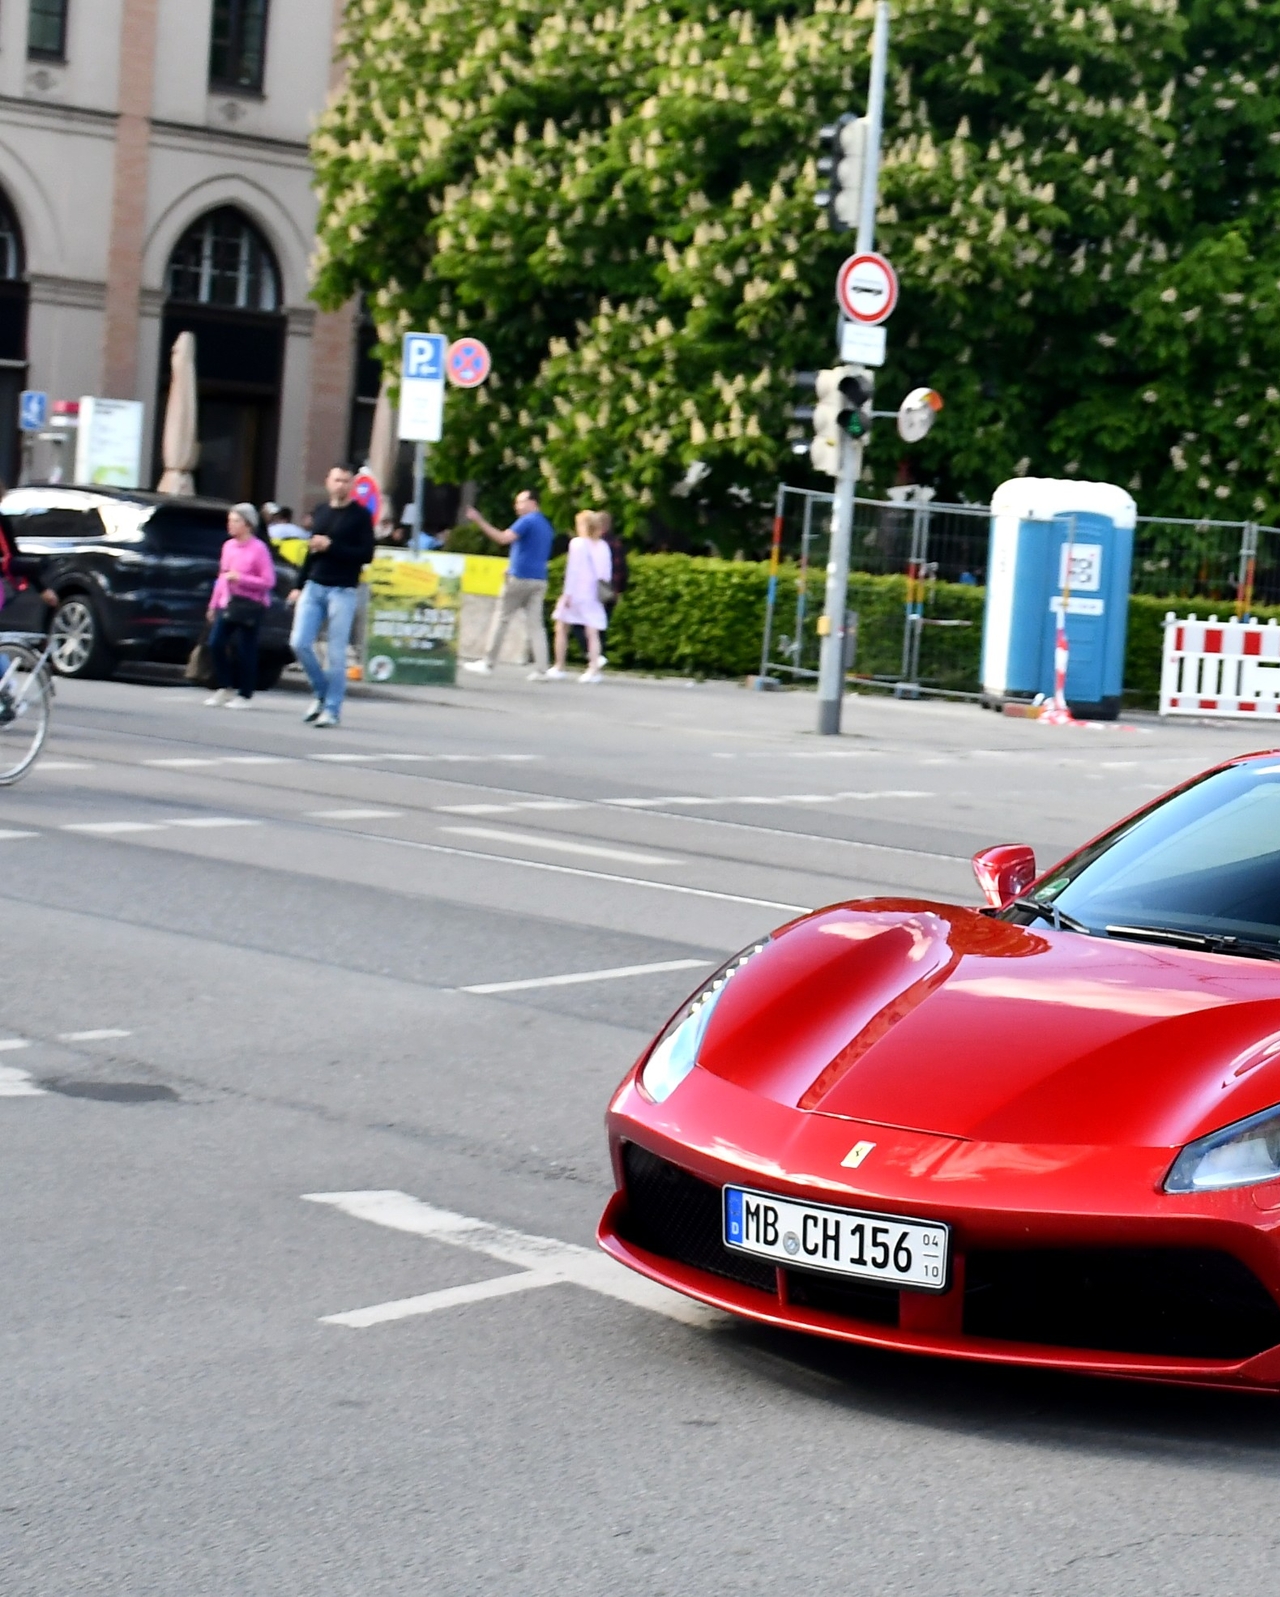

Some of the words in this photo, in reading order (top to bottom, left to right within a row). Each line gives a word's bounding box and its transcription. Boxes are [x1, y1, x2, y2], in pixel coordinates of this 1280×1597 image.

[409, 340, 434, 375] P
[731, 1222, 739, 1235] D
[745, 1199, 779, 1246] MB
[802, 1213, 840, 1261] CH
[850, 1223, 912, 1273] 156
[923, 1234, 939, 1247] 04
[924, 1265, 939, 1277] 10
